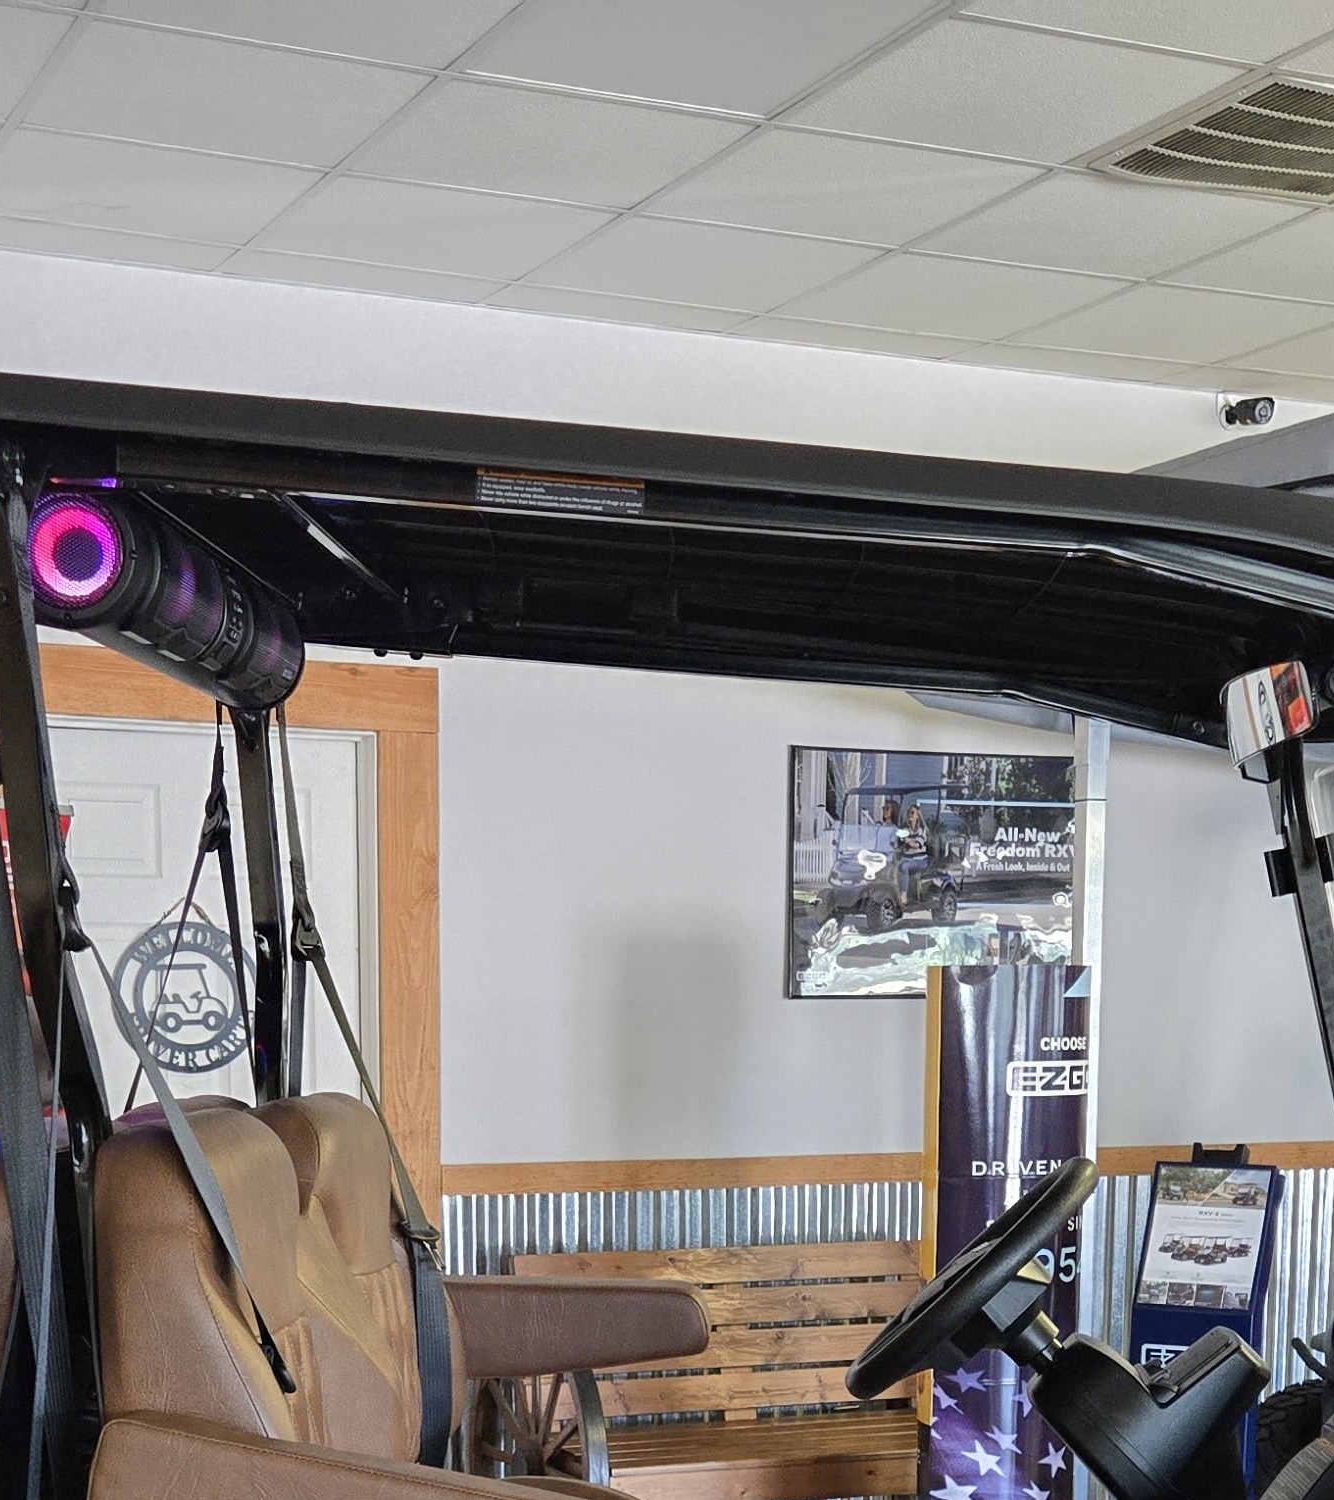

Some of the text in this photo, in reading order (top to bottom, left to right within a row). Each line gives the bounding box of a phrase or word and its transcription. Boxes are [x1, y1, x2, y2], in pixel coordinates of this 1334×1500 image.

[994, 826, 1061, 843] All-New
[969, 842, 1041, 858] Freedom
[975, 861, 1070, 873] A Fresh Look, Inside & Out
[1040, 1036, 1087, 1051] CHOOSE
[971, 1160, 1063, 1177] DRVEN
